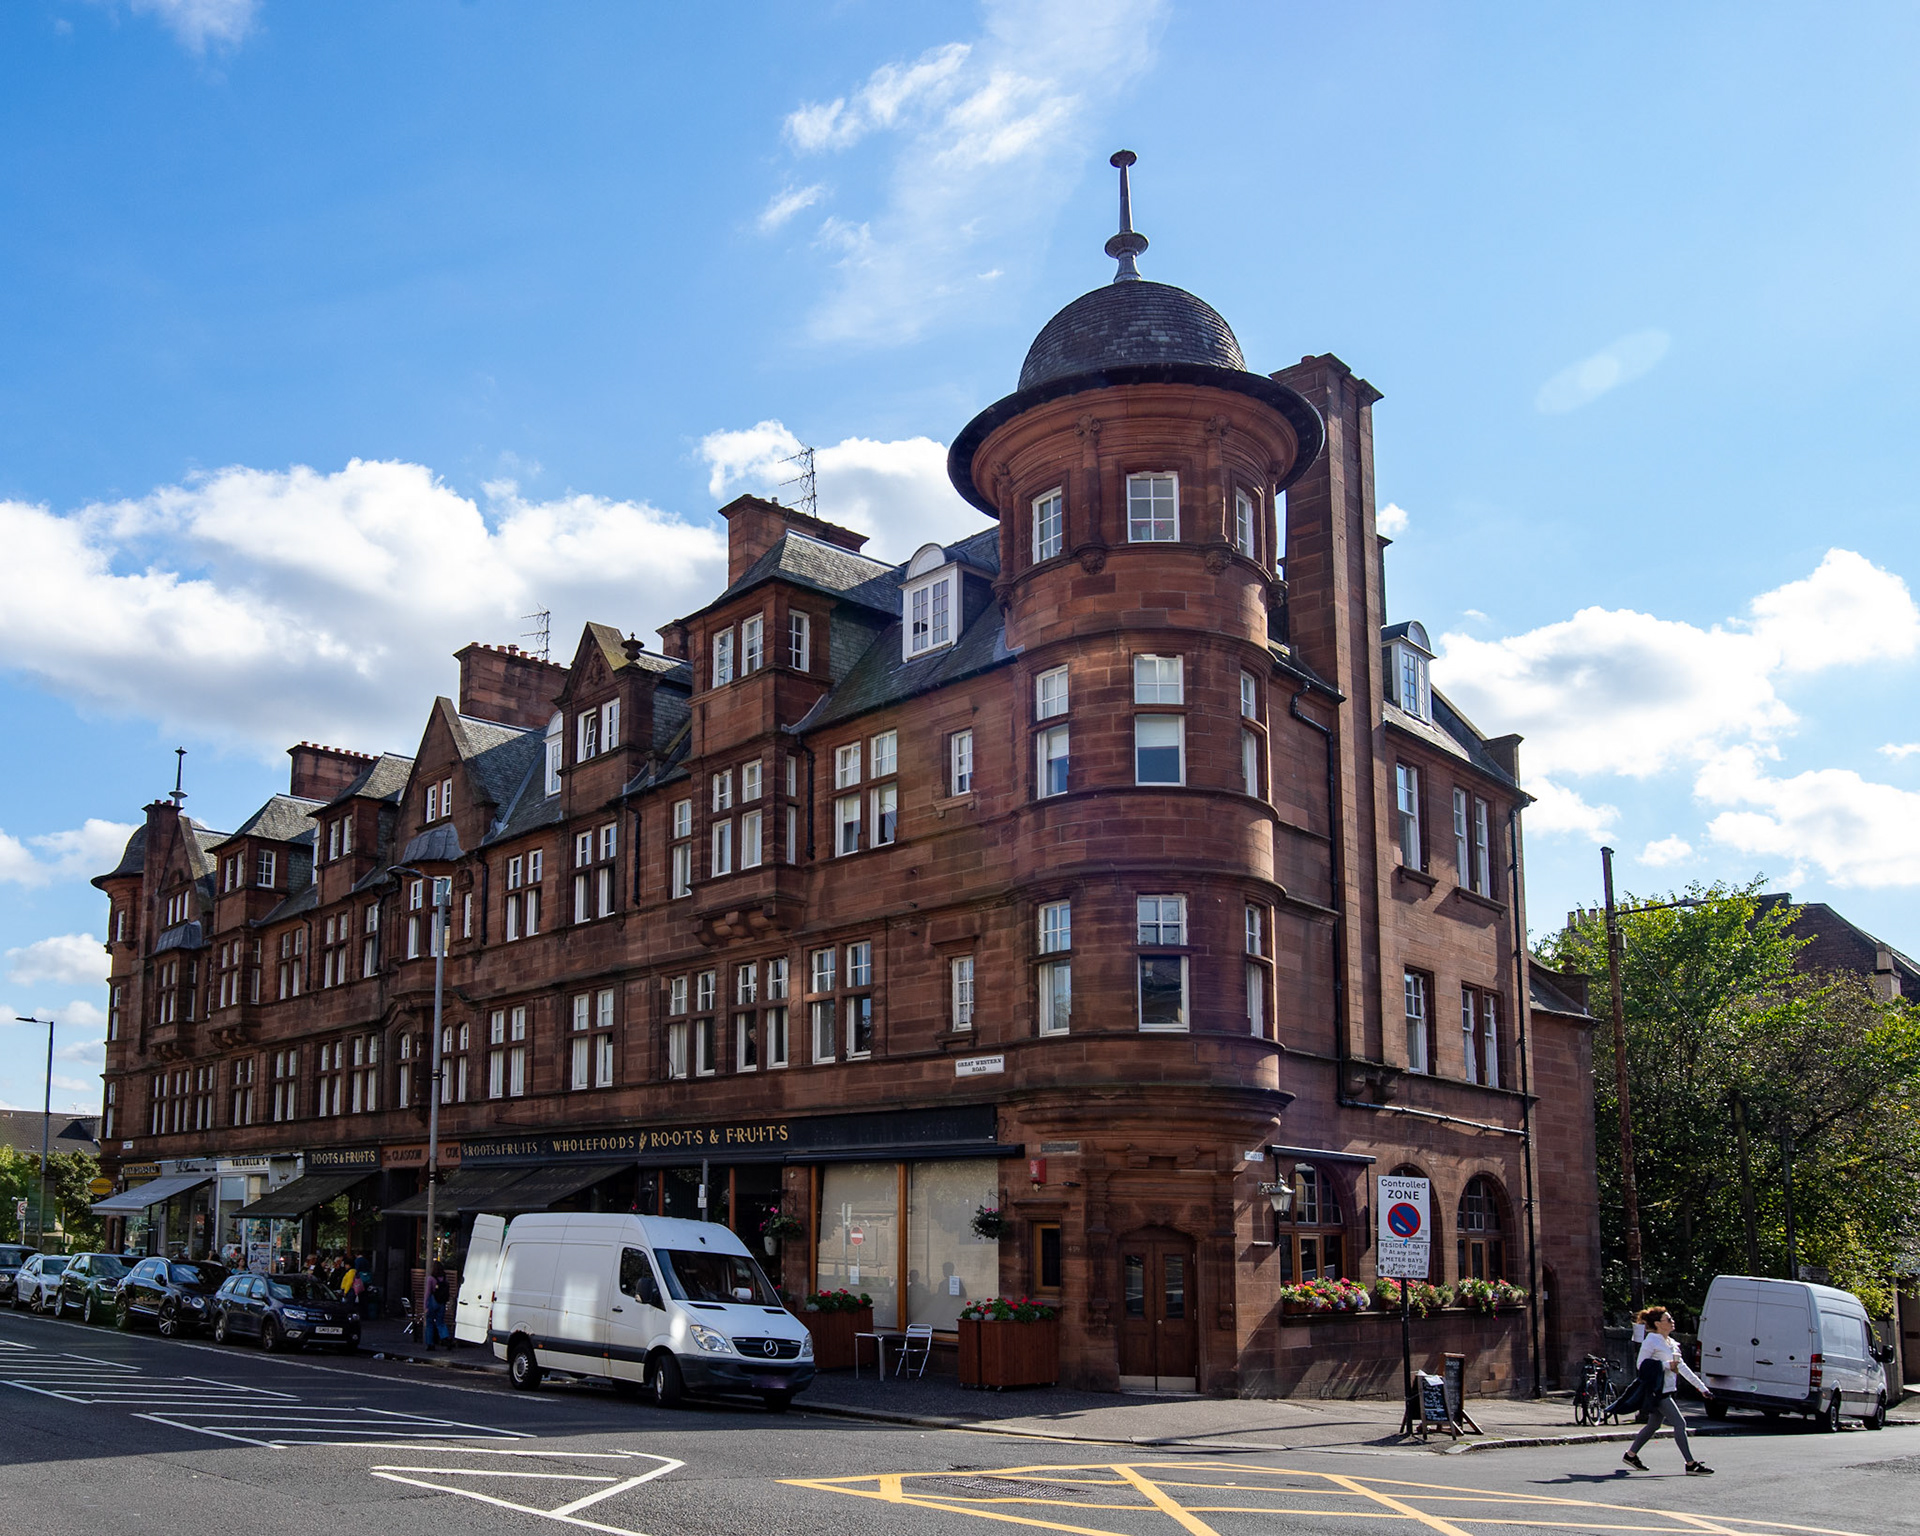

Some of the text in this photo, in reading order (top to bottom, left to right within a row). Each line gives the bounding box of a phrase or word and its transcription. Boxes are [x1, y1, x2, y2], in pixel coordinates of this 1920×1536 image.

[709, 1128, 720, 1145] &
[1381, 1179, 1427, 1189] Controlled
[1387, 1189, 1420, 1200] ZONE
